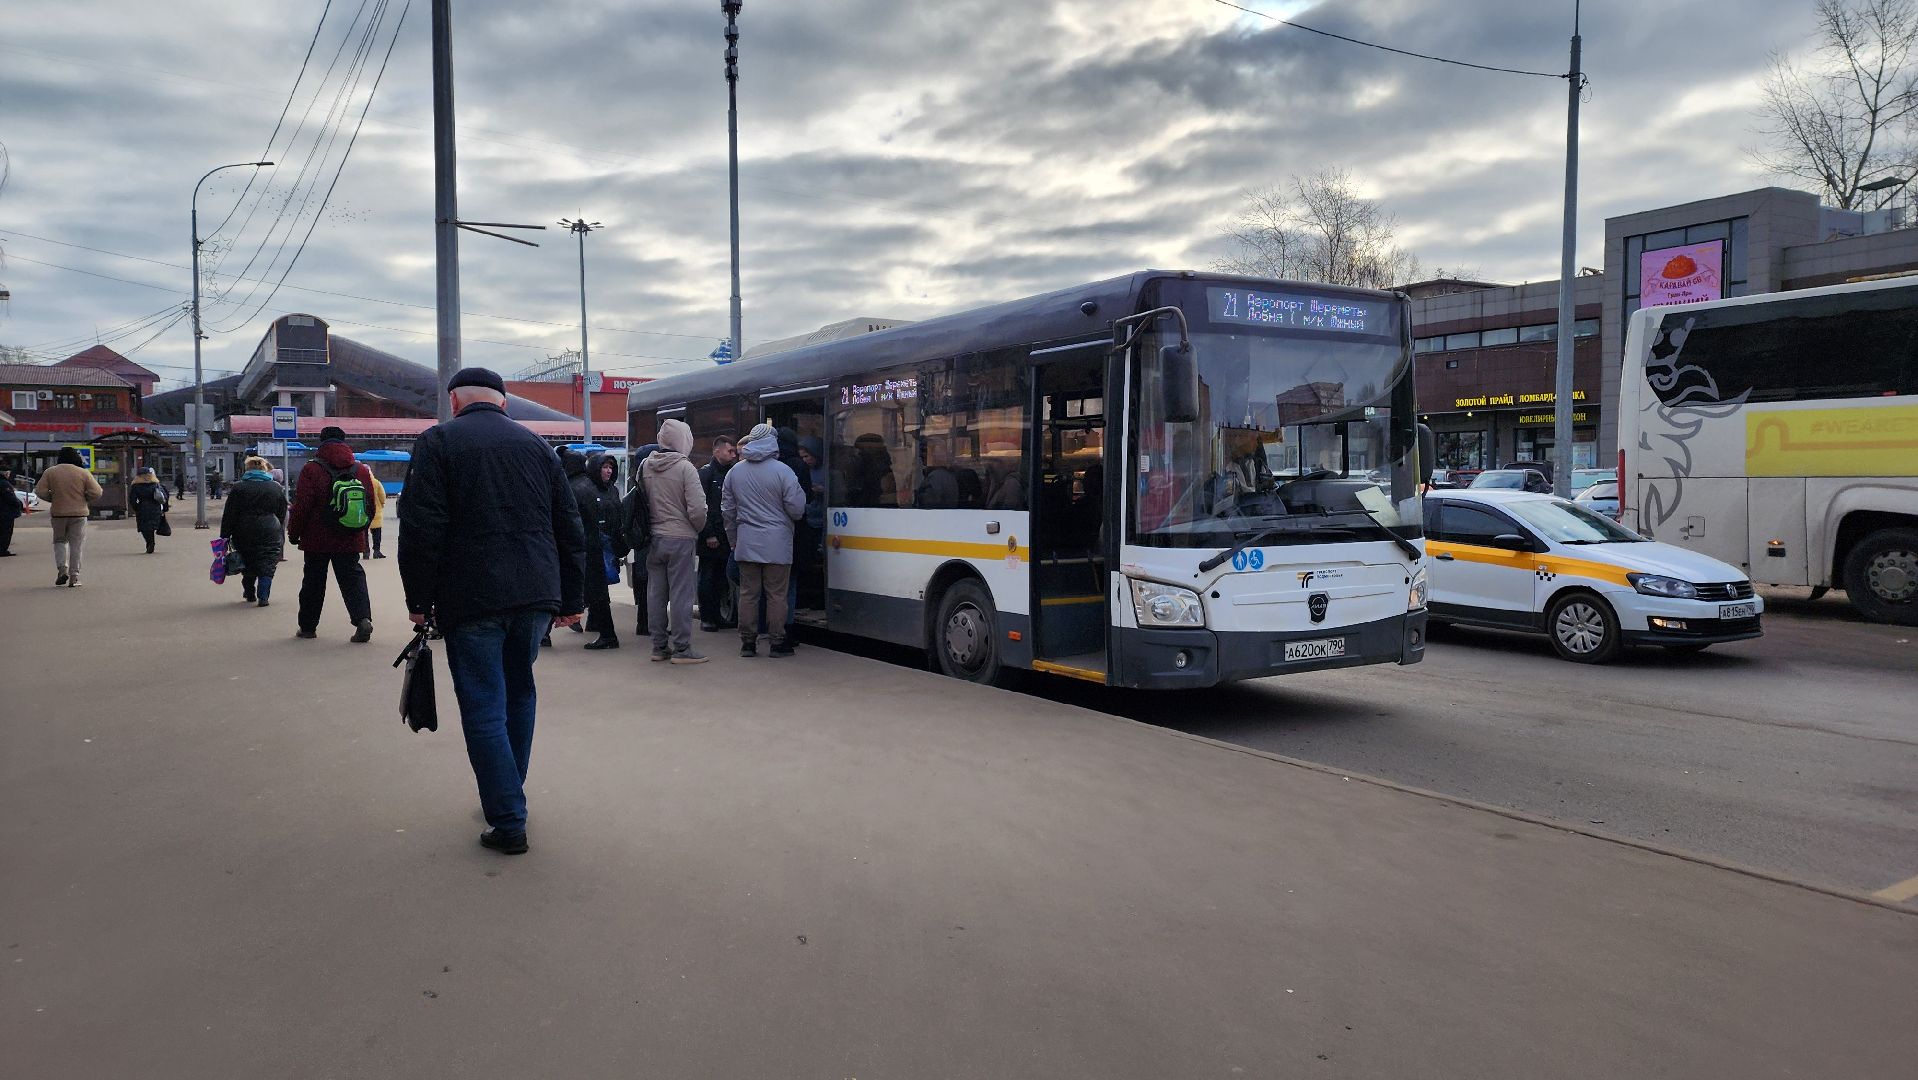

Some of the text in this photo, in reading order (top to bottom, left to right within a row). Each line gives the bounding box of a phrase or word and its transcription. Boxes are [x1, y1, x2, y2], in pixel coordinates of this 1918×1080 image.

[1223, 293, 1239, 317] 21
[1247, 307, 1283, 323] Лобня
[1455, 395, 1487, 407] ЗОЛОТОЙ
[1489, 393, 1514, 406] ПРАЙД
